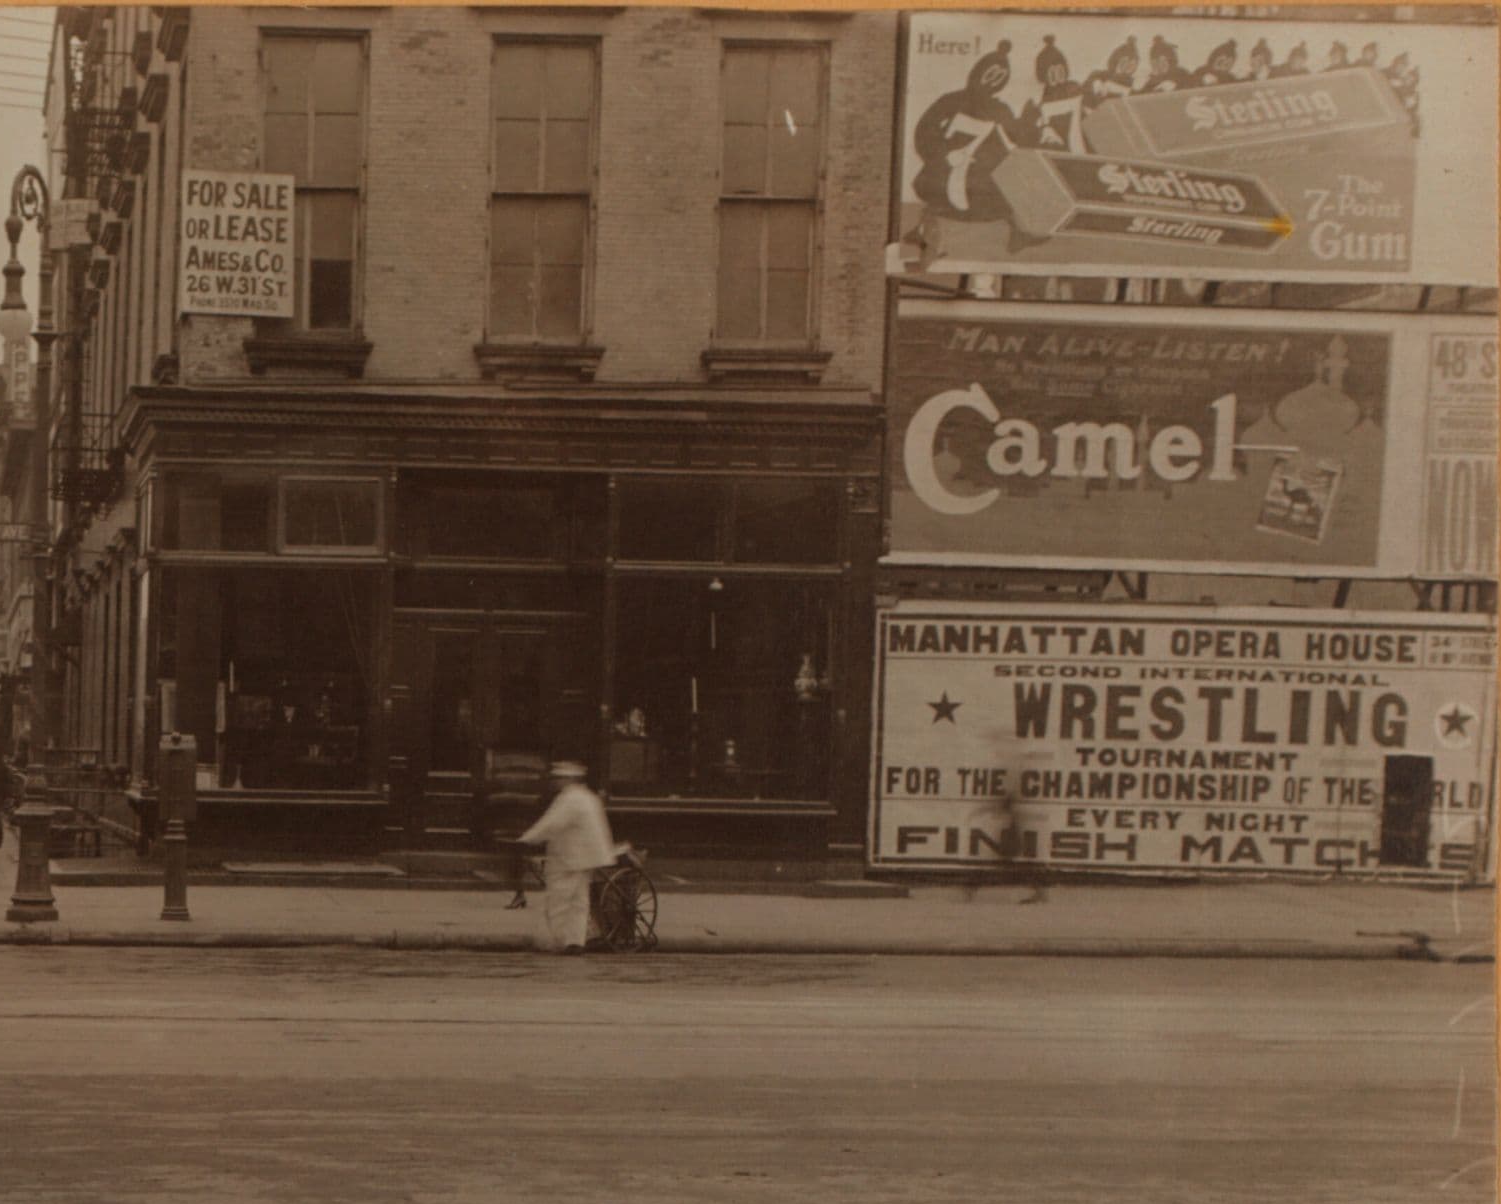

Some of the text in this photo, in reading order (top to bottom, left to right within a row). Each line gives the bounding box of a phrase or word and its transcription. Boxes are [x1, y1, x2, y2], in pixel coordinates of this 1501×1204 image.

[916, 33, 982, 56] Here!
[1186, 90, 1338, 132] Sterling
[187, 179, 288, 211] FOR SALE
[1098, 164, 1246, 213] Sterling
[1338, 174, 1385, 195] The
[1303, 188, 1405, 221] 7-Point
[186, 214, 288, 244] OR LEASE
[1127, 216, 1224, 246] Sterling
[1308, 220, 1407, 262] Gum
[187, 274, 211, 293] 26
[948, 325, 1026, 354] MAN
[904, 382, 1237, 516] Camel
[888, 624, 1418, 664] MANHATTAN OPERA HOUSE
[993, 664, 1390, 688] SECOND INTERNATIONAL
[1013, 682, 1410, 748] WRESTLING
[1075, 746, 1298, 773] TOURNAMENT
[886, 766, 941, 796] FOR
[957, 767, 1008, 798] THE
[1020, 768, 1272, 803] CHAMPIONSHIP
[1284, 777, 1313, 804] OF
[1323, 778, 1374, 807] THE
[1066, 807, 1309, 834] EVERY NIGHT
[896, 825, 1476, 872] FINISH MATCHS
